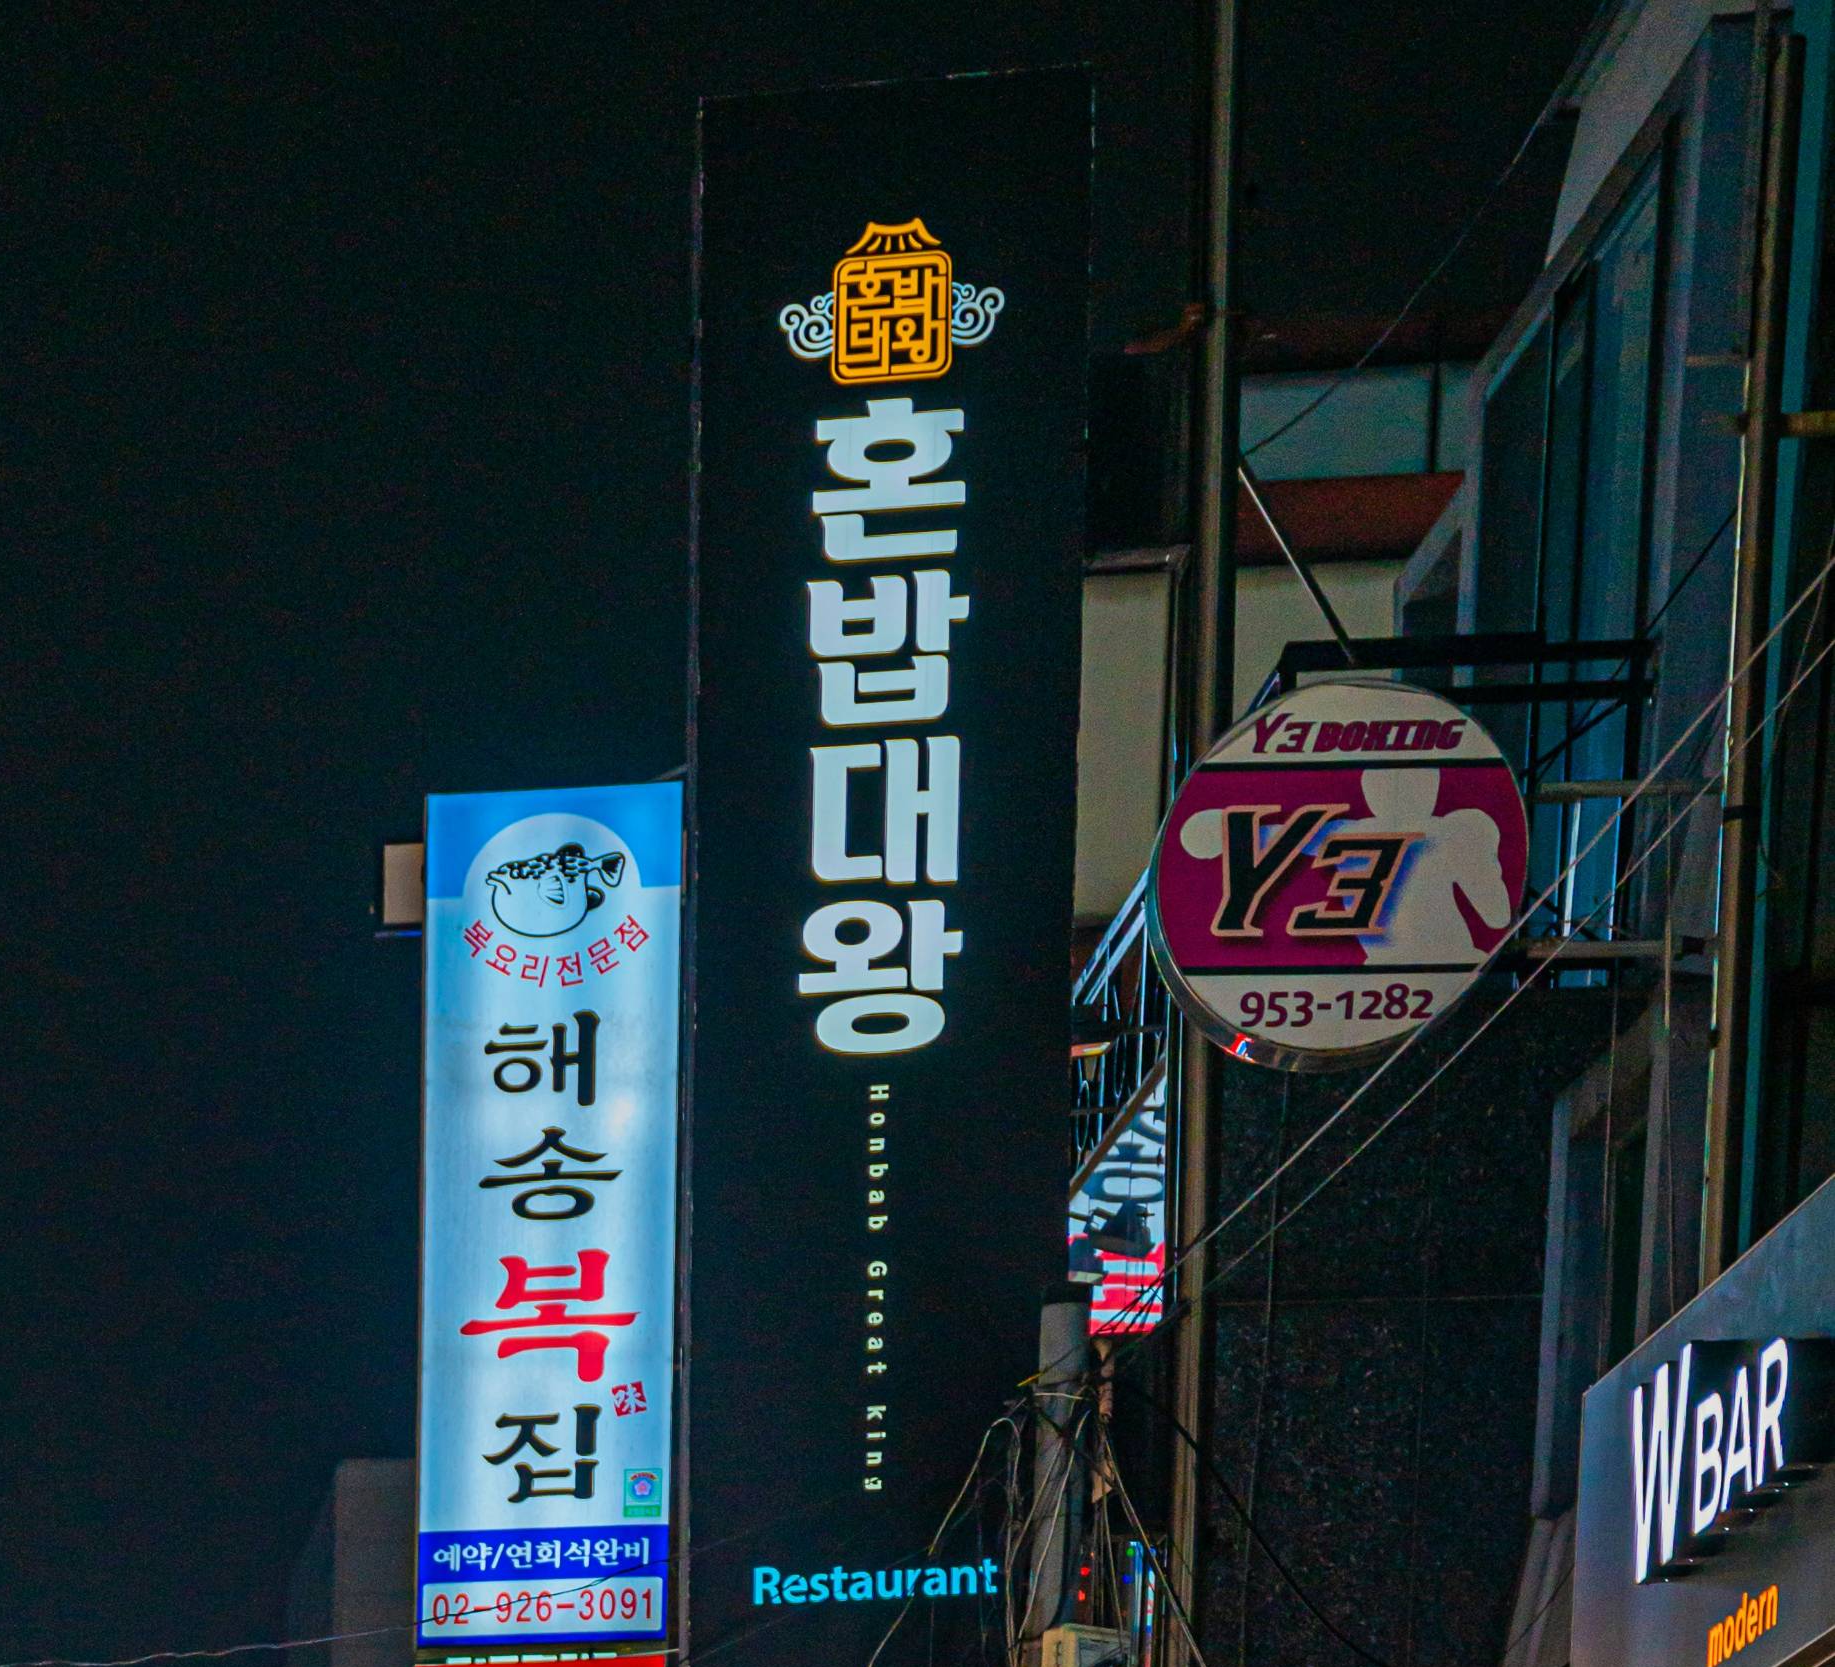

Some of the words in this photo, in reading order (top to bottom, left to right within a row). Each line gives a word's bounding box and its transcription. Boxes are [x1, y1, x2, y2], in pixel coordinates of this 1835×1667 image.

[797, 397, 970, 1054] 혼밥대왕
[463, 913, 651, 989] 복요리전문점
[1240, 984, 1433, 1028] 953-1282
[868, 1084, 889, 1231] Honbab
[459, 1008, 640, 1504] 해송복집
[868, 1260, 888, 1374] Great
[1692, 1337, 1789, 1537] BAR
[432, 1540, 651, 1572] 예약/연회석완비
[753, 1557, 999, 1605] Restaurant
[431, 1591, 655, 1626] 02-926-3091
